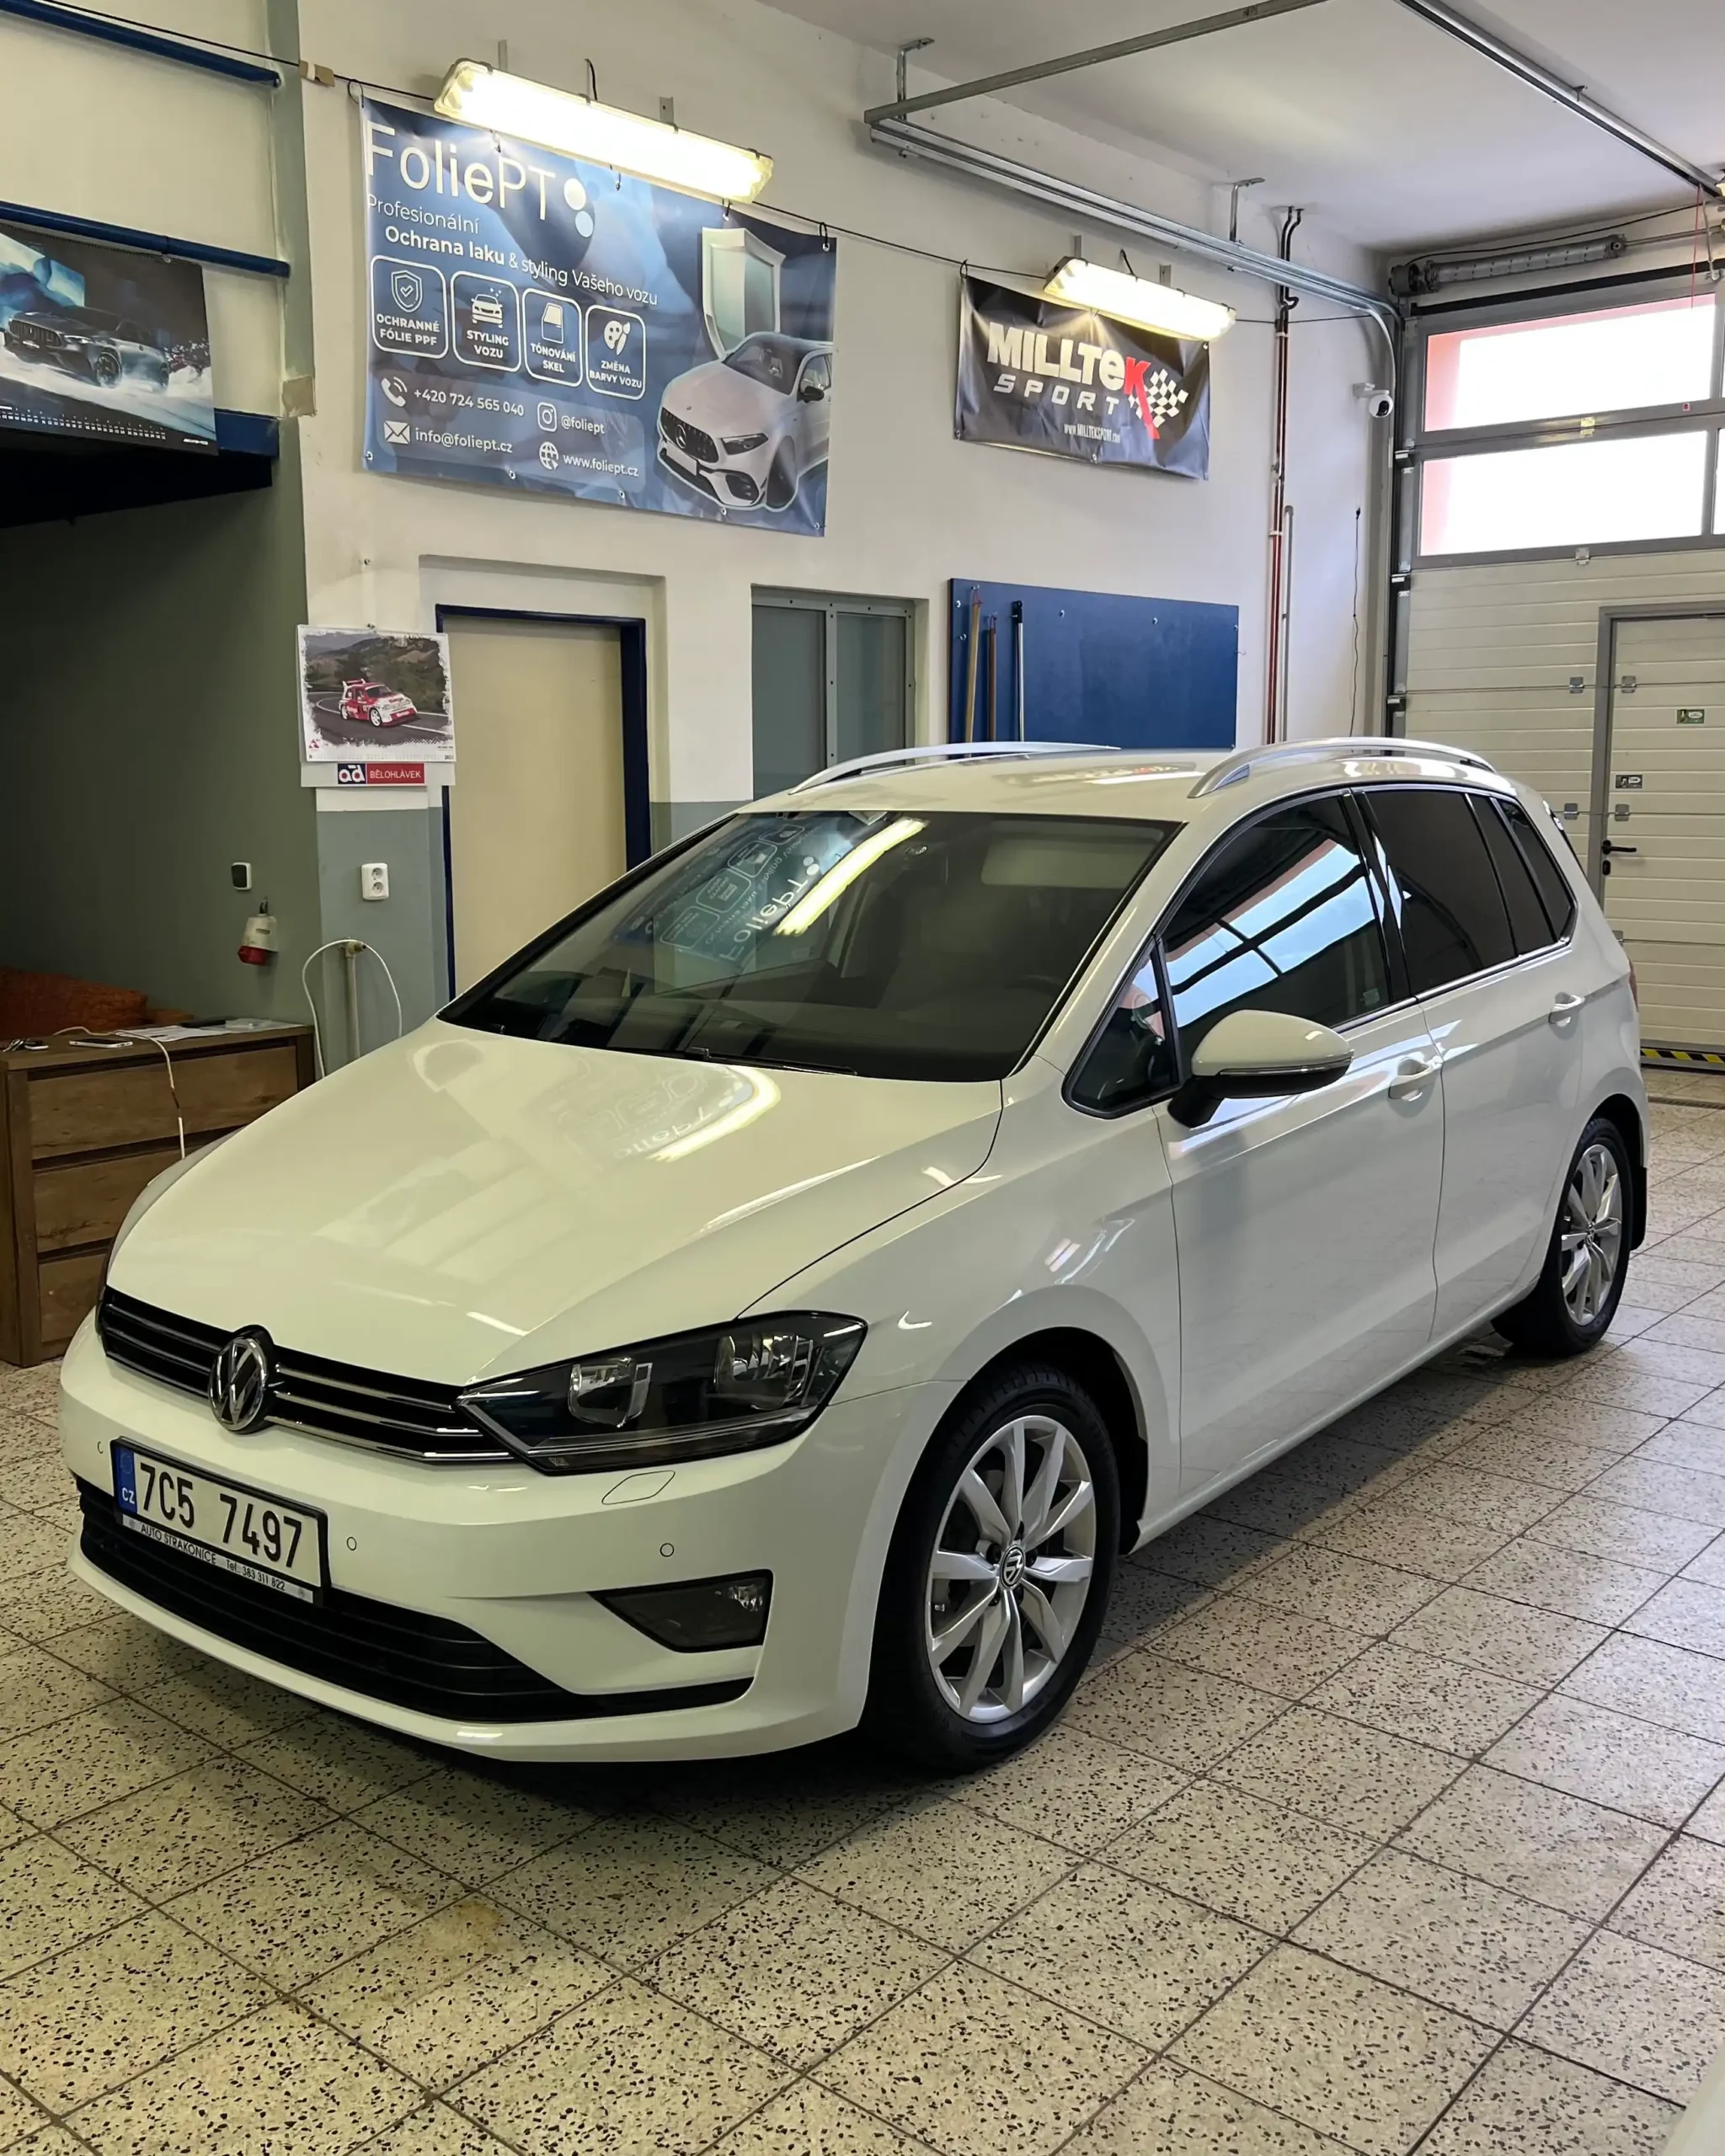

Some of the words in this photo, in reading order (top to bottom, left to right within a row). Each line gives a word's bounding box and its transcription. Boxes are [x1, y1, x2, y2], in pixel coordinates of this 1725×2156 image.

[367, 120, 556, 220] FoliePT
[368, 194, 480, 235] Profesionální
[385, 226, 464, 256] Ochrana
[469, 241, 505, 265] laku
[509, 253, 519, 270] &
[522, 259, 569, 287] styling
[572, 270, 623, 298] Vašeho
[626, 286, 658, 306] vozu
[377, 313, 441, 333] OCHRANNÉ
[380, 328, 412, 344] FÓLIE
[415, 334, 438, 346] PPF
[467, 329, 510, 346] STYLING
[473, 344, 504, 359] VOZU
[530, 343, 576, 363] TÓNOVÁNÍ
[542, 360, 565, 373] SKEL
[601, 360, 631, 374] ZMĚNA
[590, 370, 618, 383] BARVY
[619, 376, 643, 388] VOZU
[414, 388, 446, 403] +420
[449, 392, 474, 408] 724
[477, 397, 500, 411] 565
[503, 401, 525, 417] 040
[993, 375, 1120, 415] SPORT
[561, 415, 605, 435] @foliept
[415, 427, 514, 454] info@foliept.cz
[563, 454, 639, 477] www.foliept.cz
[370, 768, 422, 780] BĚLOHLÁVEK
[122, 1487, 135, 1504] CZ
[141, 1462, 195, 1529] 7C5
[220, 1493, 302, 1568] 7497
[141, 1524, 162, 1540] AUTO
[164, 1533, 216, 1565] STRAKONICE
[243, 1566, 256, 1580] 383
[258, 1572, 269, 1584] 311
[271, 1577, 286, 1592] 822
